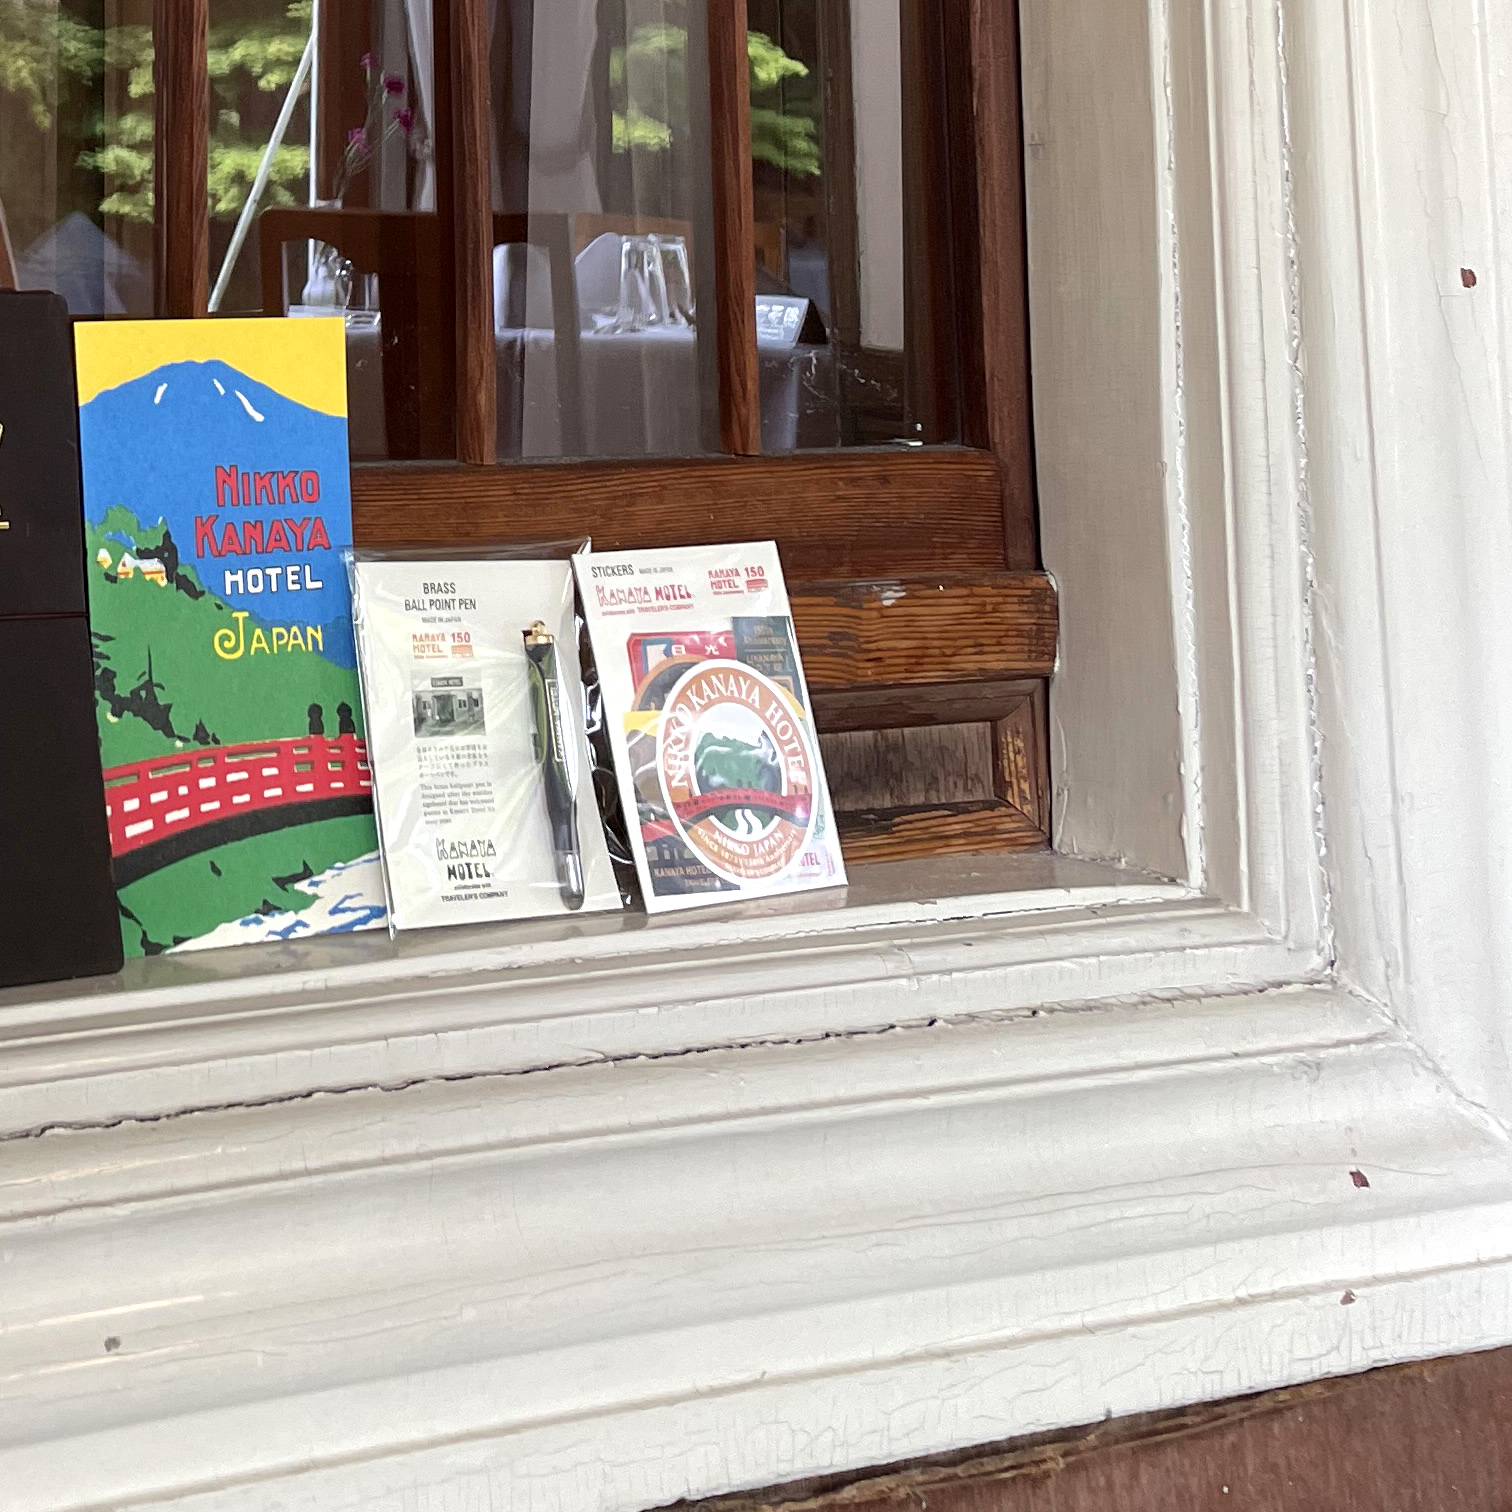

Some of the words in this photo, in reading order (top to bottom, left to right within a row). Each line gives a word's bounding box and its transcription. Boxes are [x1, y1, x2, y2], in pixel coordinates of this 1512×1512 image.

[215, 464, 320, 507] NIKKO
[194, 514, 331, 558] KANAYA
[224, 564, 323, 595] HOTEL
[591, 564, 634, 578] STICKERS
[745, 566, 765, 578] 150
[422, 582, 456, 594] BRASS
[595, 585, 652, 606] KANAYA
[404, 599, 427, 611] BALL
[429, 599, 457, 611] POINT
[459, 598, 477, 610] PEN
[213, 611, 324, 660] JAPAN
[451, 632, 471, 643] 150
[686, 673, 760, 711] KANAYA
[436, 838, 497, 861] KANAYA
[753, 829, 784, 856] JAPAN
[654, 867, 685, 877] KANAYA
